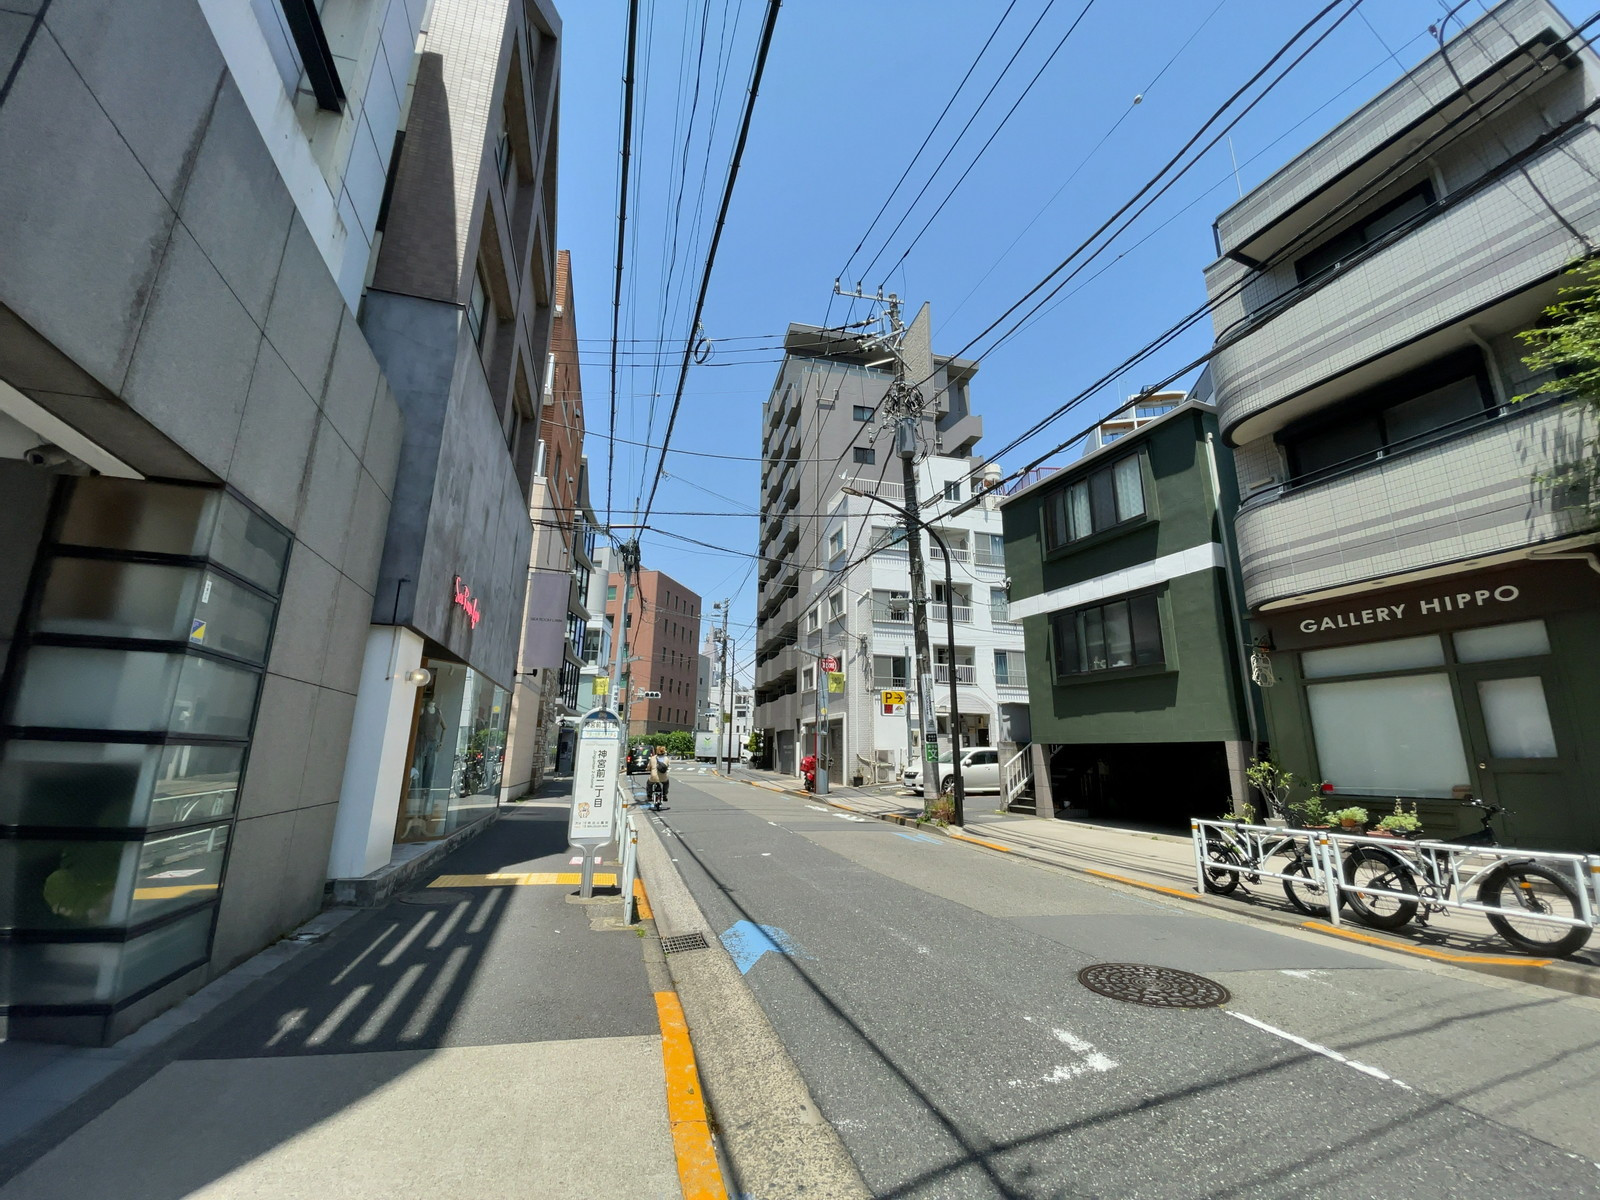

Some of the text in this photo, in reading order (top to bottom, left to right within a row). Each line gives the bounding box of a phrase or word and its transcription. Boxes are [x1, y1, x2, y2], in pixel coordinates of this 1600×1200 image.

[1300, 585, 1519, 633] GALLERY HIPPO
[885, 692, 893, 703] P
[594, 750, 608, 808] 神宮前二丁目
